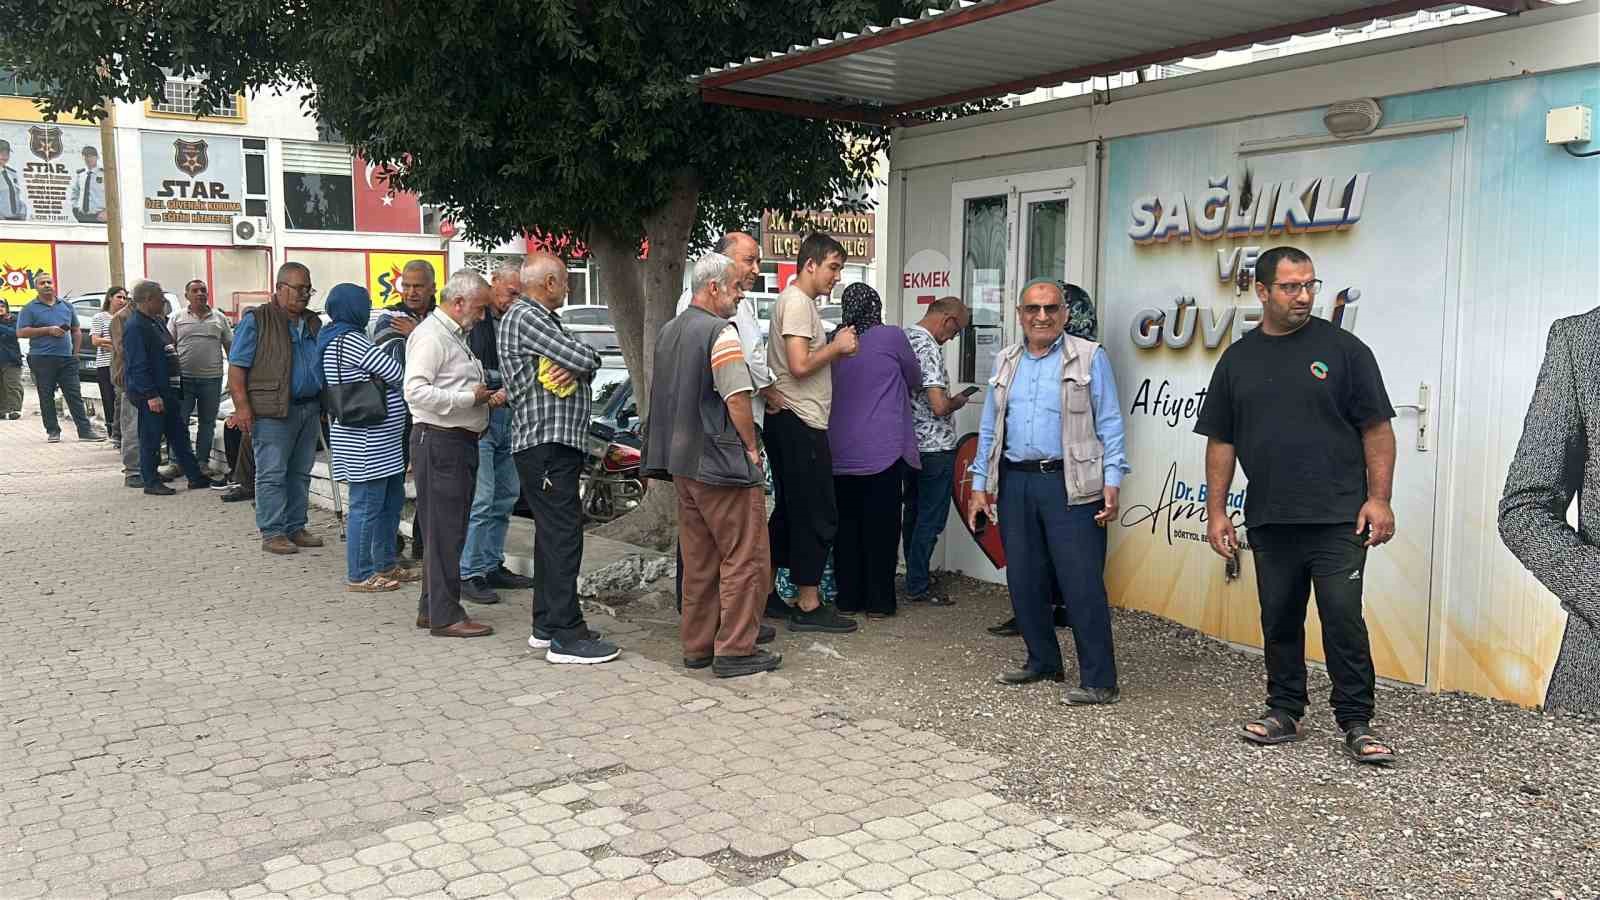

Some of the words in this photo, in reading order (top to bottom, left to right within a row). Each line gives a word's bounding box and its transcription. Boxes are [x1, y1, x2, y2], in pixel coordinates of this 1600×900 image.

[23, 162, 69, 174] STAR
[157, 180, 229, 199] STAR
[1128, 174, 1371, 242] SAĞLIKLI
[774, 235, 799, 257] İLÇE
[1216, 247, 1262, 282] VE
[903, 271, 951, 289] EKMEK
[1130, 379, 1207, 427] Afiyet
[1175, 481, 1194, 501] Dr.
